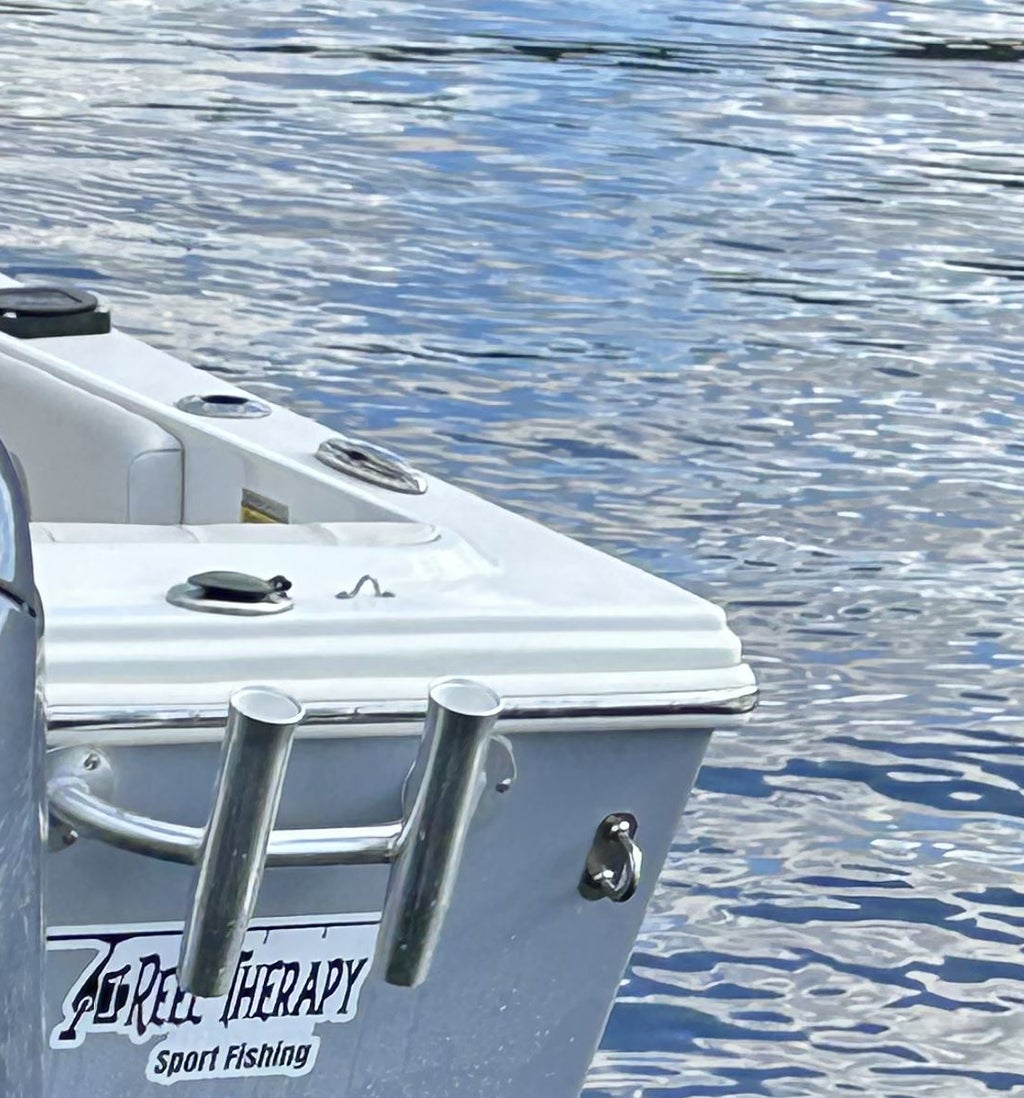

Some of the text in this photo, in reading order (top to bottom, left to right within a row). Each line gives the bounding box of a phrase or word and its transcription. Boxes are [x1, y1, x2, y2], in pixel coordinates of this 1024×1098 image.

[219, 949, 369, 1029] THERAPY
[154, 1040, 313, 1078] Sport Fishing
